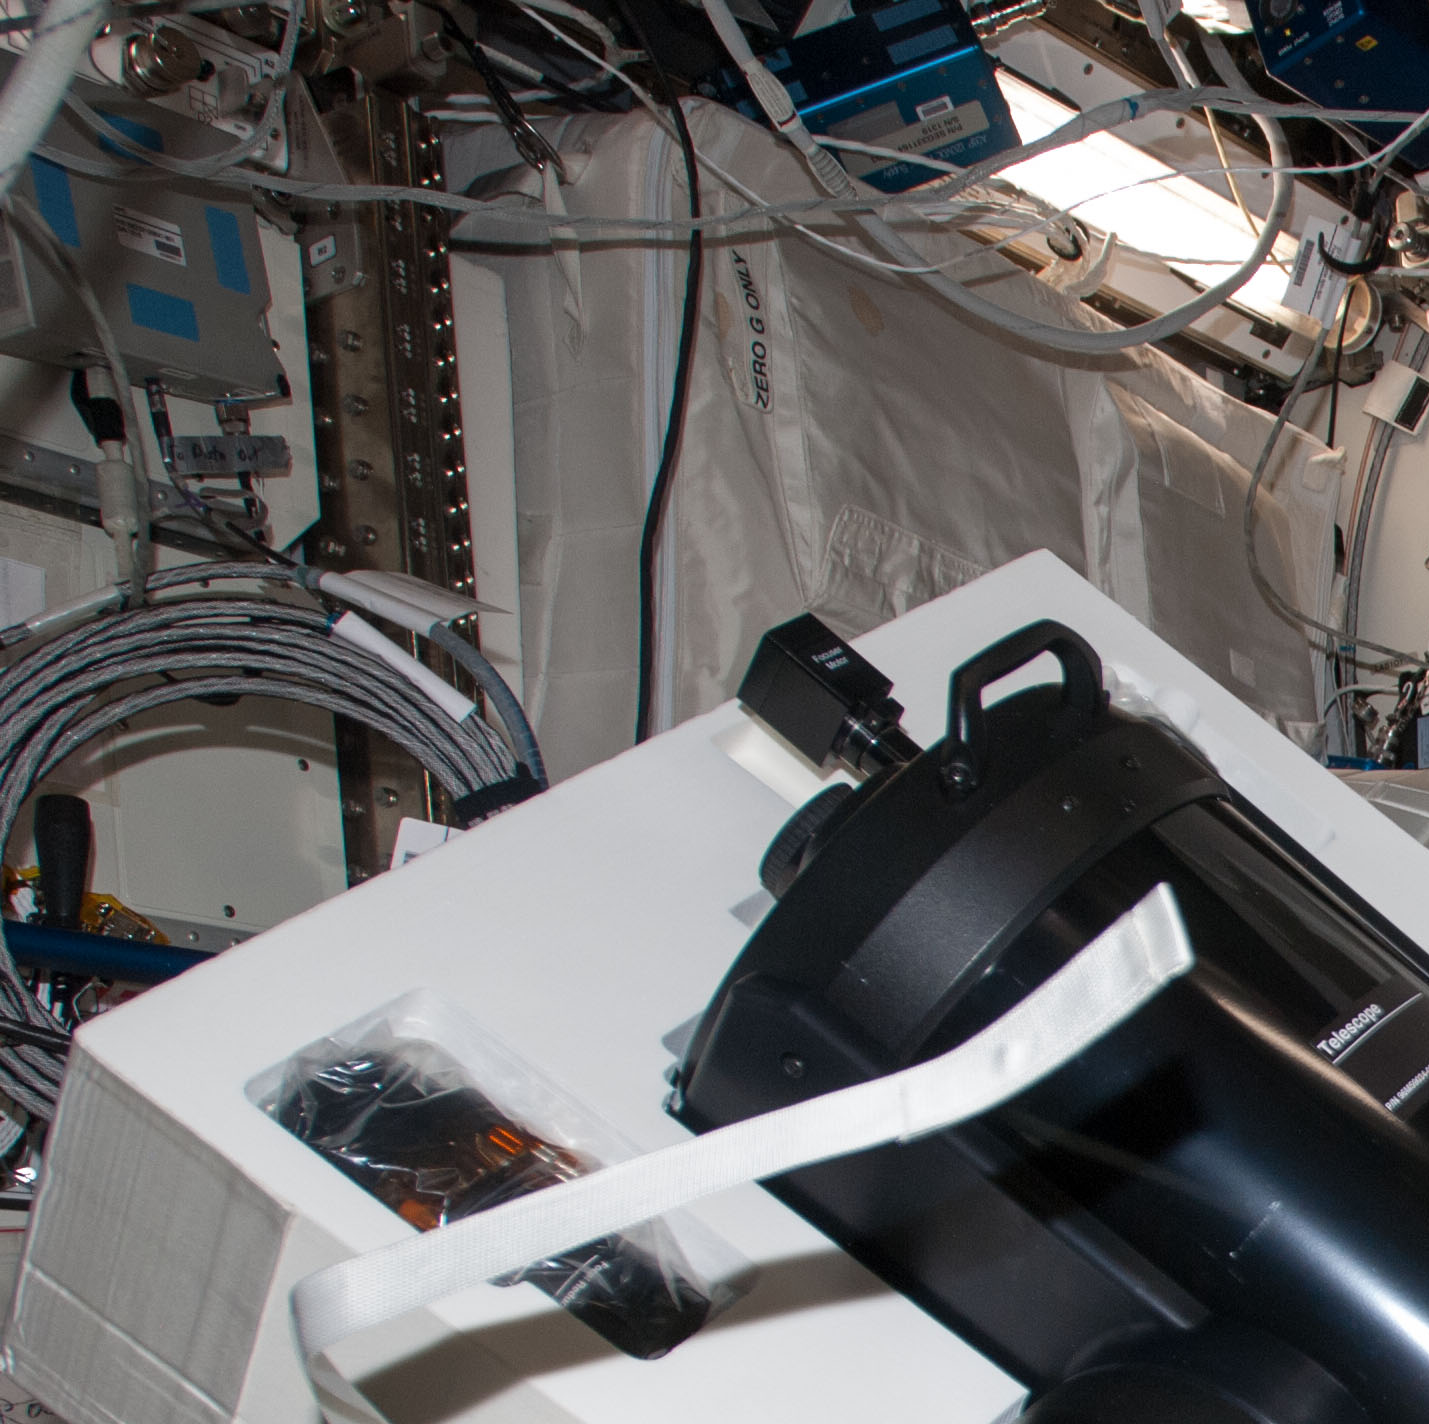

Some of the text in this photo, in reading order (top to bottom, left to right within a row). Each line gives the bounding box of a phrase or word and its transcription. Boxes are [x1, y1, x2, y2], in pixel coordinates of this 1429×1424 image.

[732, 249, 770, 409] ZERO G ONLY
[811, 646, 843, 664] Focuser
[825, 657, 849, 671] Motor
[1317, 1003, 1382, 1055] Telescope
[1385, 1096, 1401, 1113] P/N
